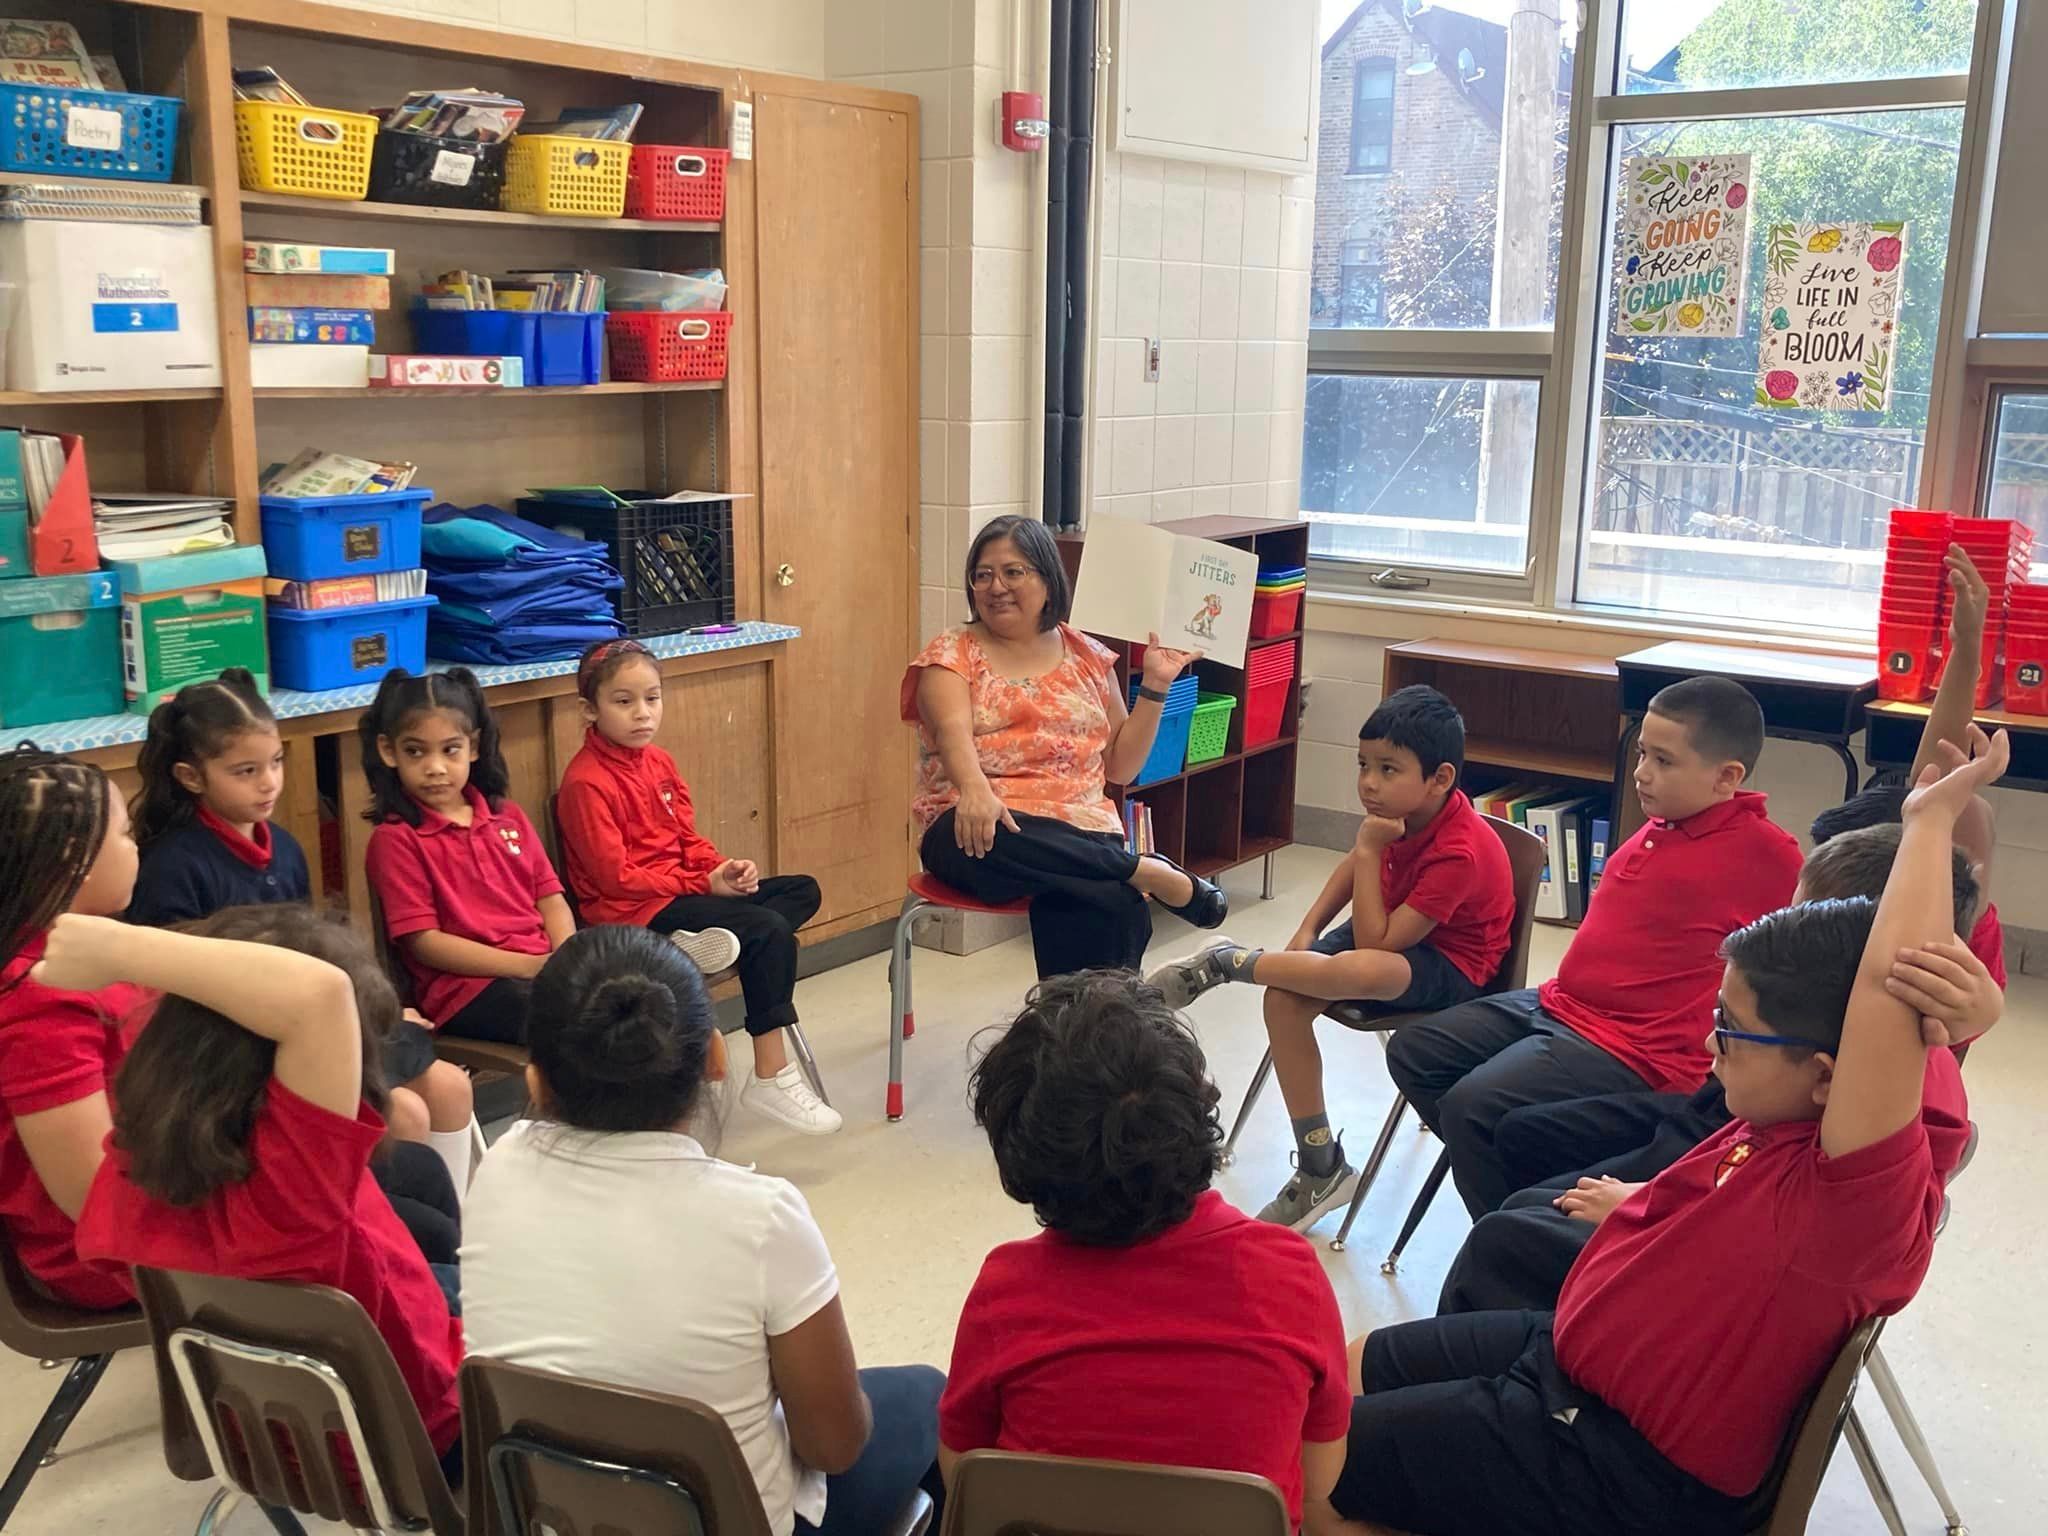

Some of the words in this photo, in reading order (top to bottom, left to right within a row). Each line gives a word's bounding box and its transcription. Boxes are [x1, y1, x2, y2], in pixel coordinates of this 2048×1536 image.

[74, 119, 112, 143] Poetry
[1649, 182, 1719, 215] Keep
[1646, 209, 1721, 250] GOING
[1638, 248, 1712, 281] Keep
[1800, 263, 1860, 285] Live
[97, 287, 170, 299] Mathematics
[1626, 266, 1726, 314] GROWING
[1796, 287, 1829, 307] LIFE
[1837, 286, 1858, 306] IN
[130, 311, 143, 326] 2
[1807, 309, 1848, 329] full
[1784, 331, 1865, 364] BLOOM
[60, 539, 76, 563] 2
[1189, 561, 1237, 586] JITTERS
[100, 581, 113, 599] 2
[1896, 656, 1905, 670] 1
[2020, 667, 2040, 683] 21
